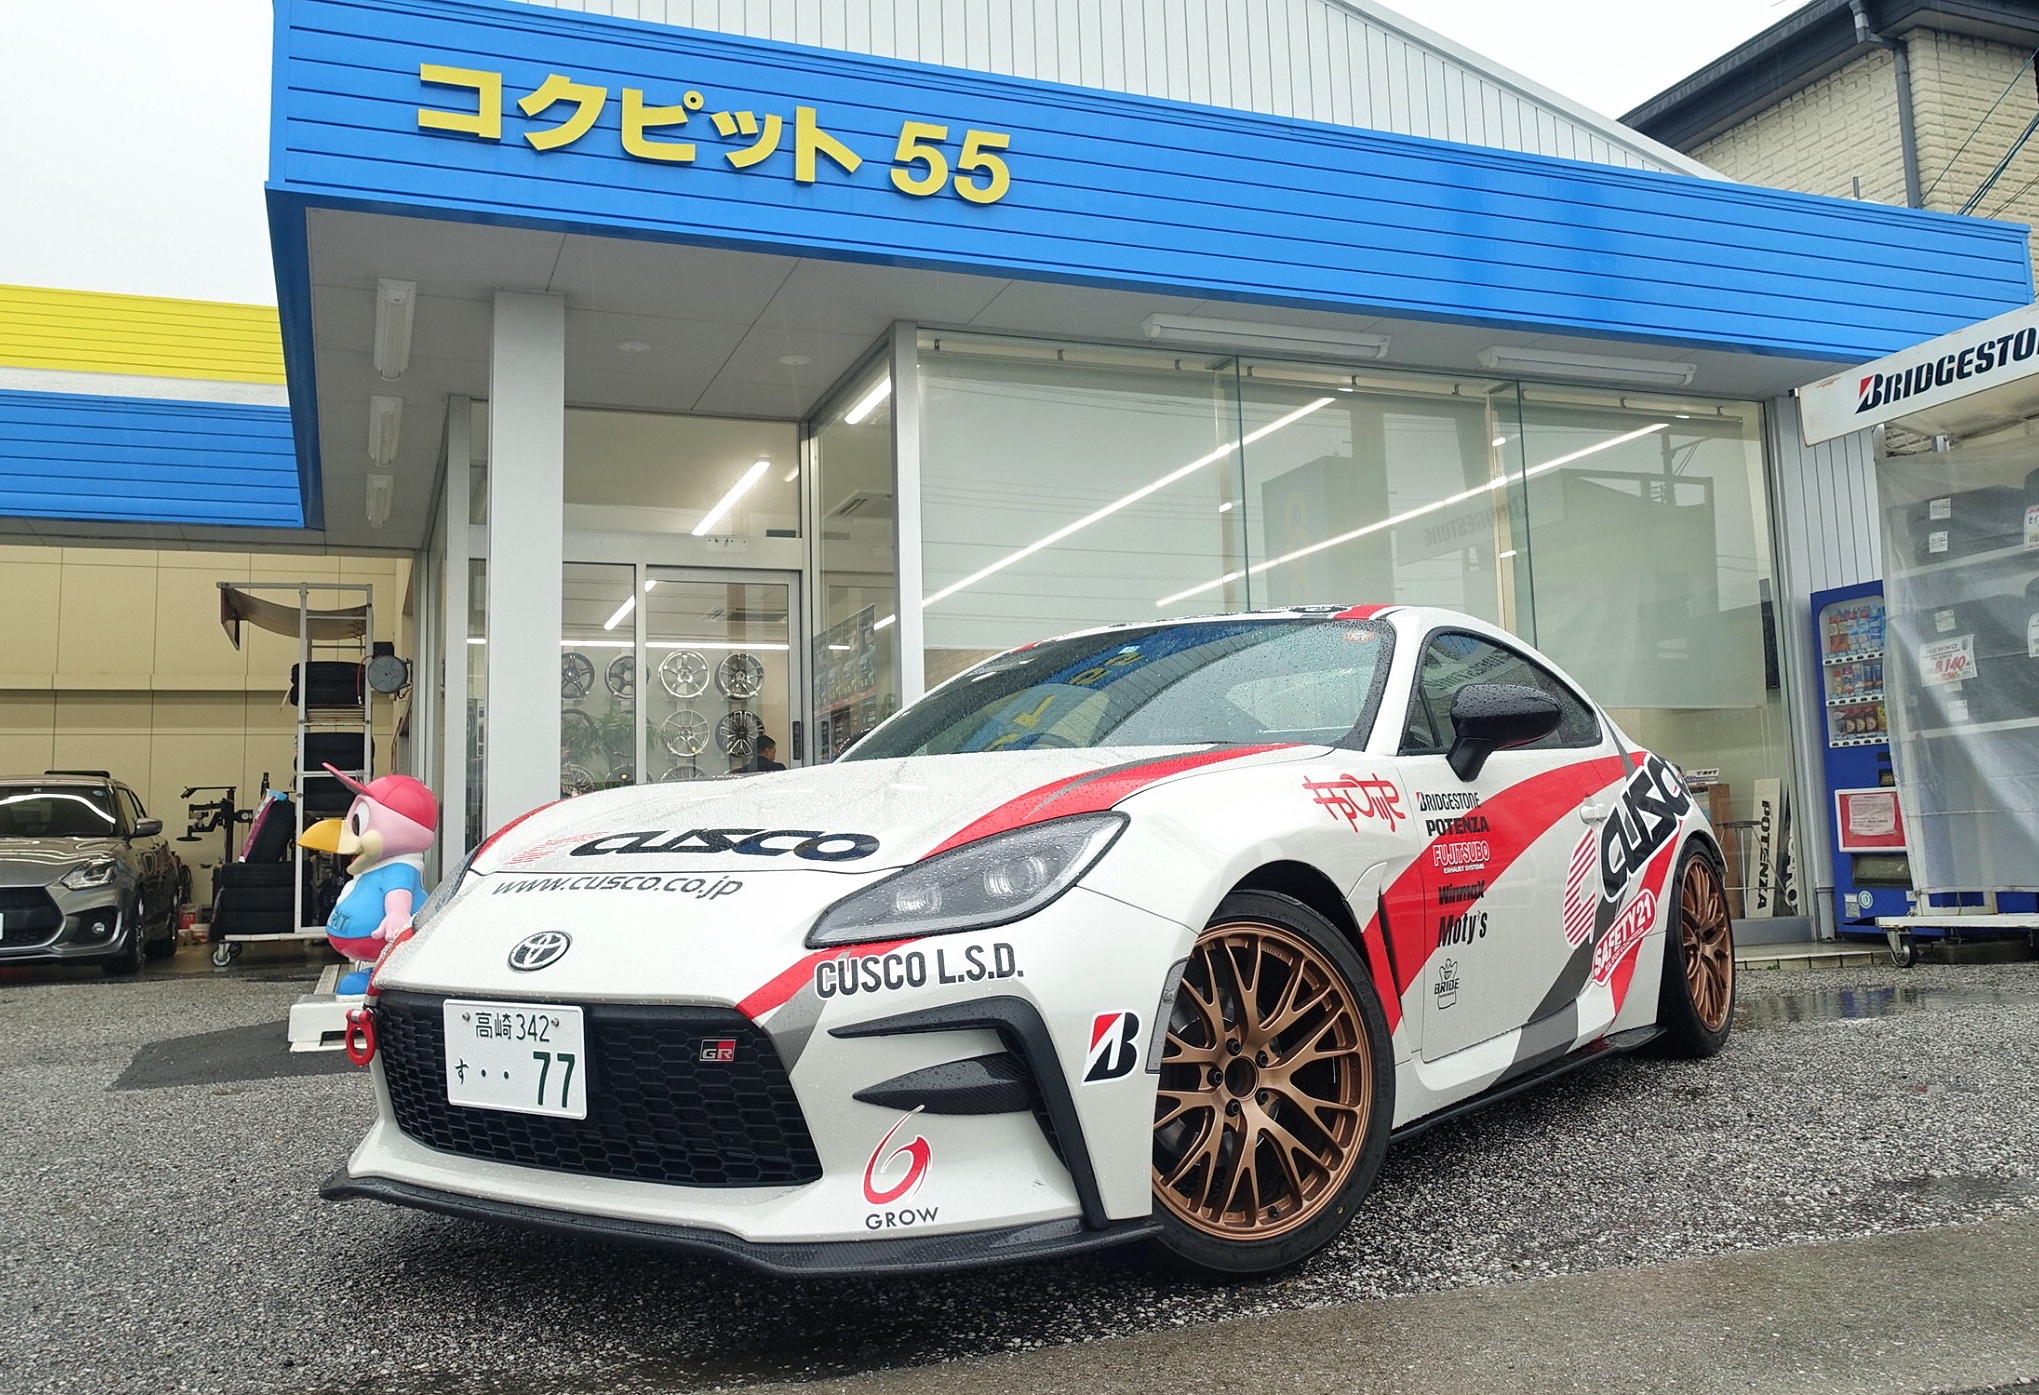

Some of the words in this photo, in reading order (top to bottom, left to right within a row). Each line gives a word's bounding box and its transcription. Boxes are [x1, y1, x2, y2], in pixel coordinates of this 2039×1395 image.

[418, 63, 863, 183] コクピット
[890, 121, 1011, 204] 55
[1855, 327, 2039, 414] BRIDGESTO
[1416, 792, 1481, 812] BRIDGESTONE
[1425, 816, 1490, 837] POTENZA
[569, 828, 881, 862] CUSCO
[1432, 840, 1491, 867] FUJITSUBO
[1758, 800, 1771, 910] POTENZA
[492, 874, 743, 900] www.cusco.co.jp
[1437, 910, 1488, 947] Moty's
[816, 951, 927, 999] CUSCO
[937, 943, 1024, 985] L.S.D.
[1434, 978, 1460, 995] BRIDE
[701, 1048, 733, 1060] GR
[865, 1206, 939, 1231] GROW
